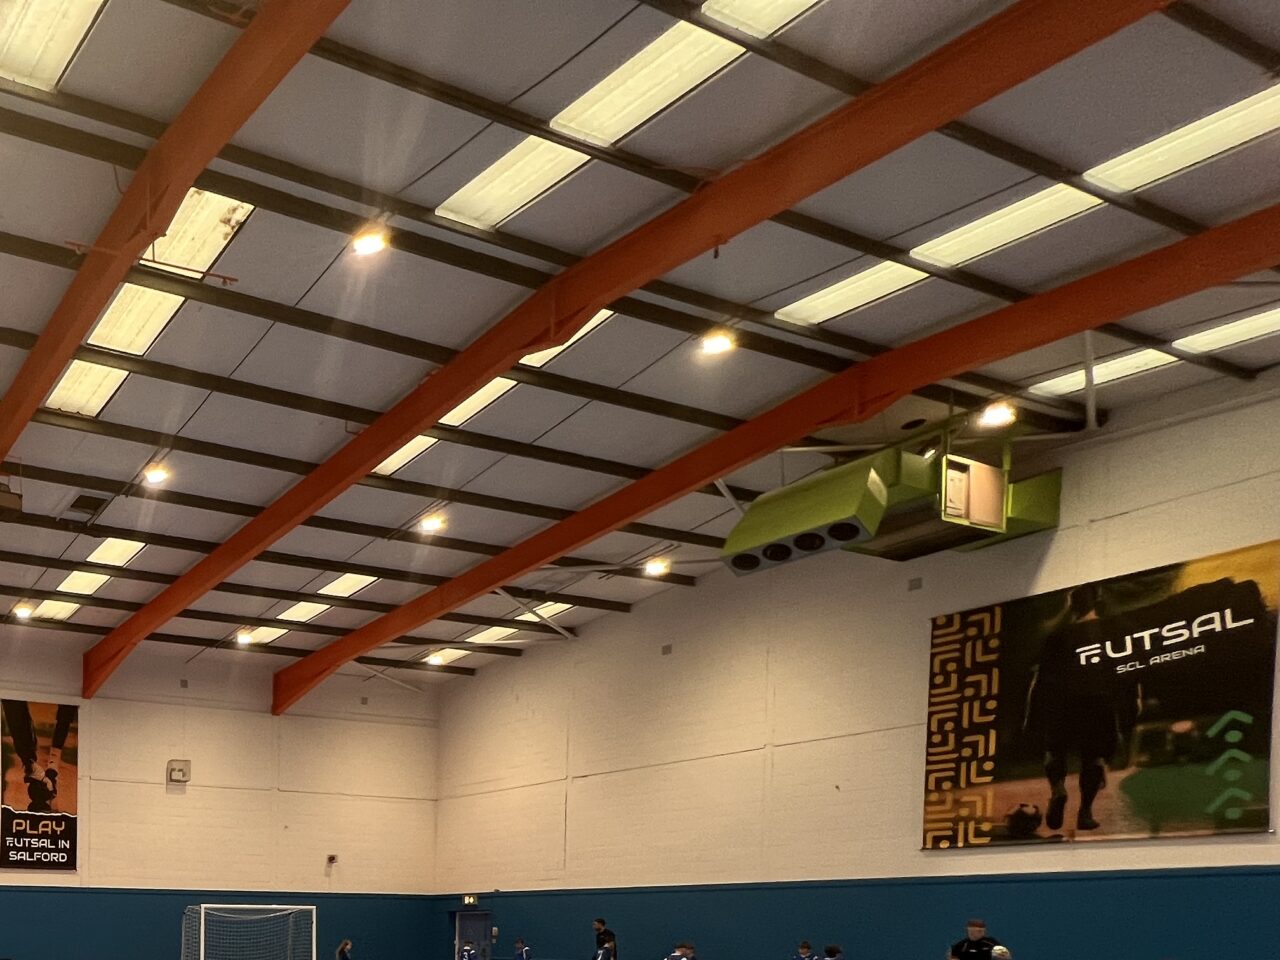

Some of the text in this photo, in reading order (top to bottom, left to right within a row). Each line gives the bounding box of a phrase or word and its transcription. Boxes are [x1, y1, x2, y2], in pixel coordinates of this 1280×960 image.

[1076, 608, 1254, 665] FUTSAL
[1116, 644, 1206, 674] SCL ARENA
[12, 819, 65, 835] PLAY
[5, 837, 70, 849] FUTSAL IN
[8, 851, 68, 862] SALFORD
